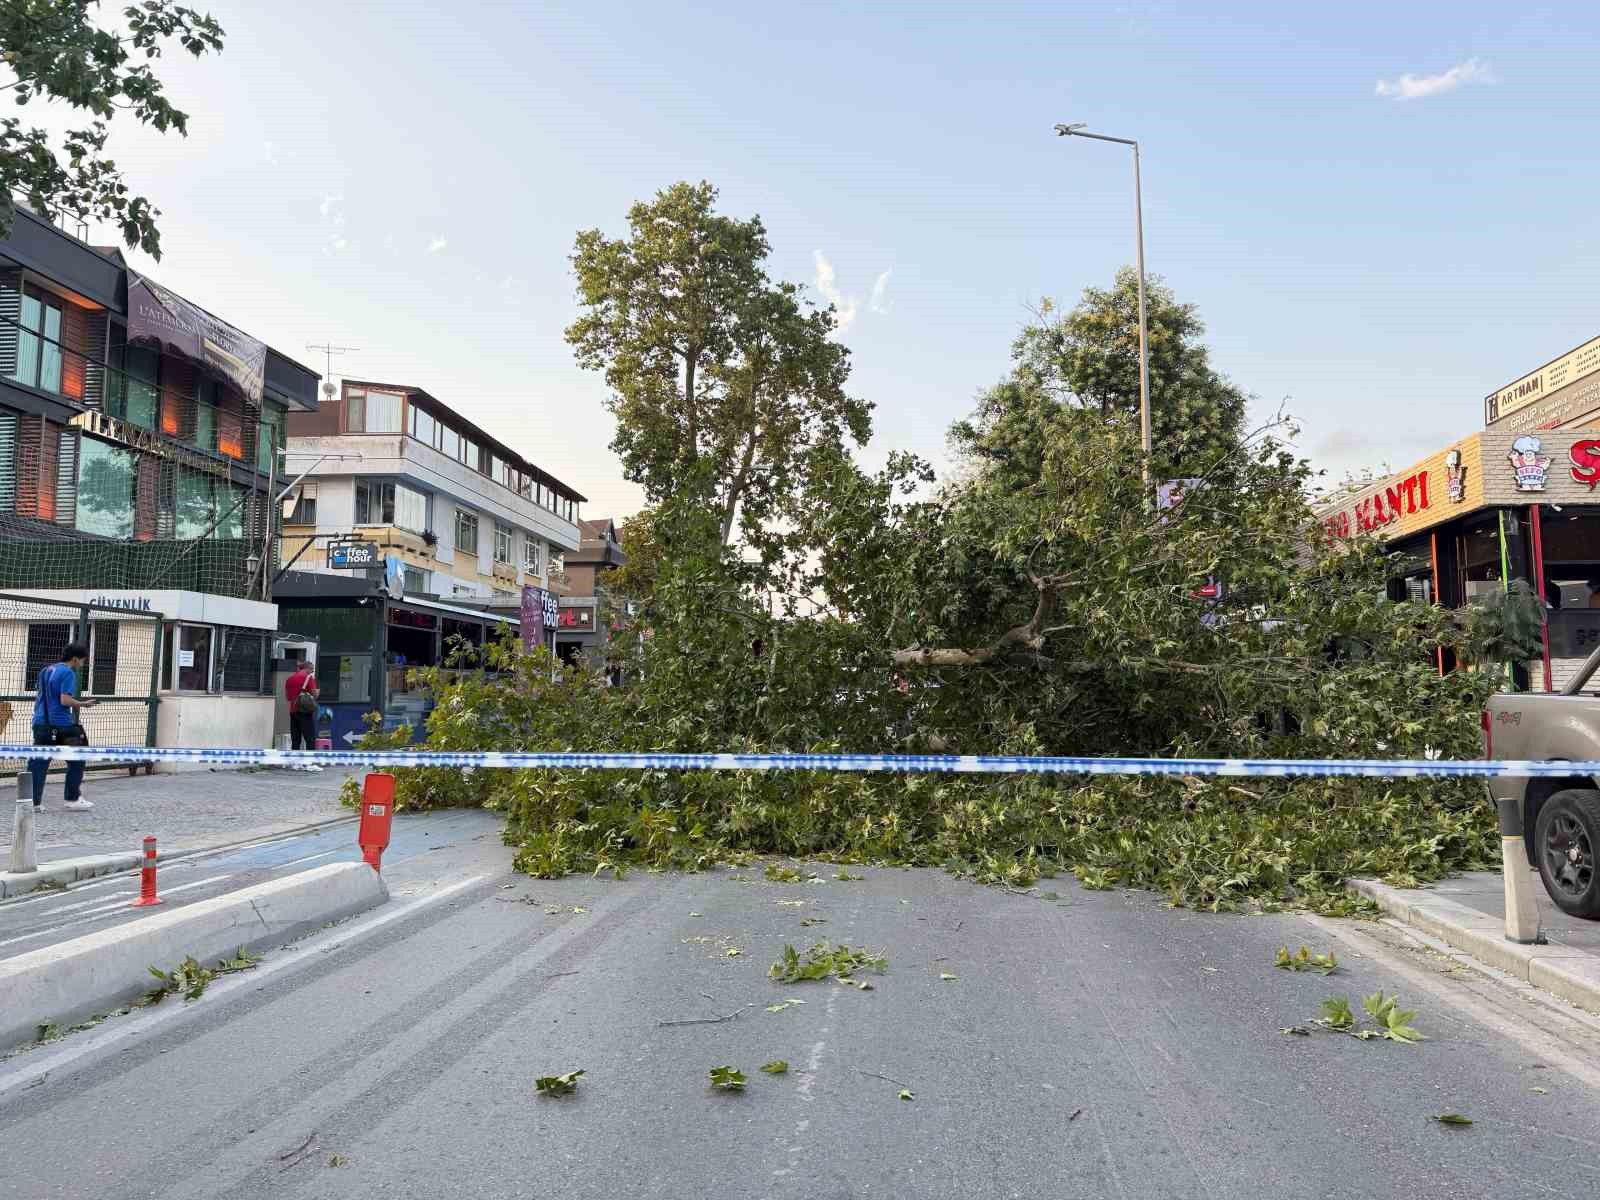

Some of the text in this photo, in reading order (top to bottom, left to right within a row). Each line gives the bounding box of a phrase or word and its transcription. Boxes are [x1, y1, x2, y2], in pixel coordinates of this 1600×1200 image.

[1511, 407, 1537, 427] GROUP
[346, 555, 372, 563] hour
[541, 590, 558, 613] ffee
